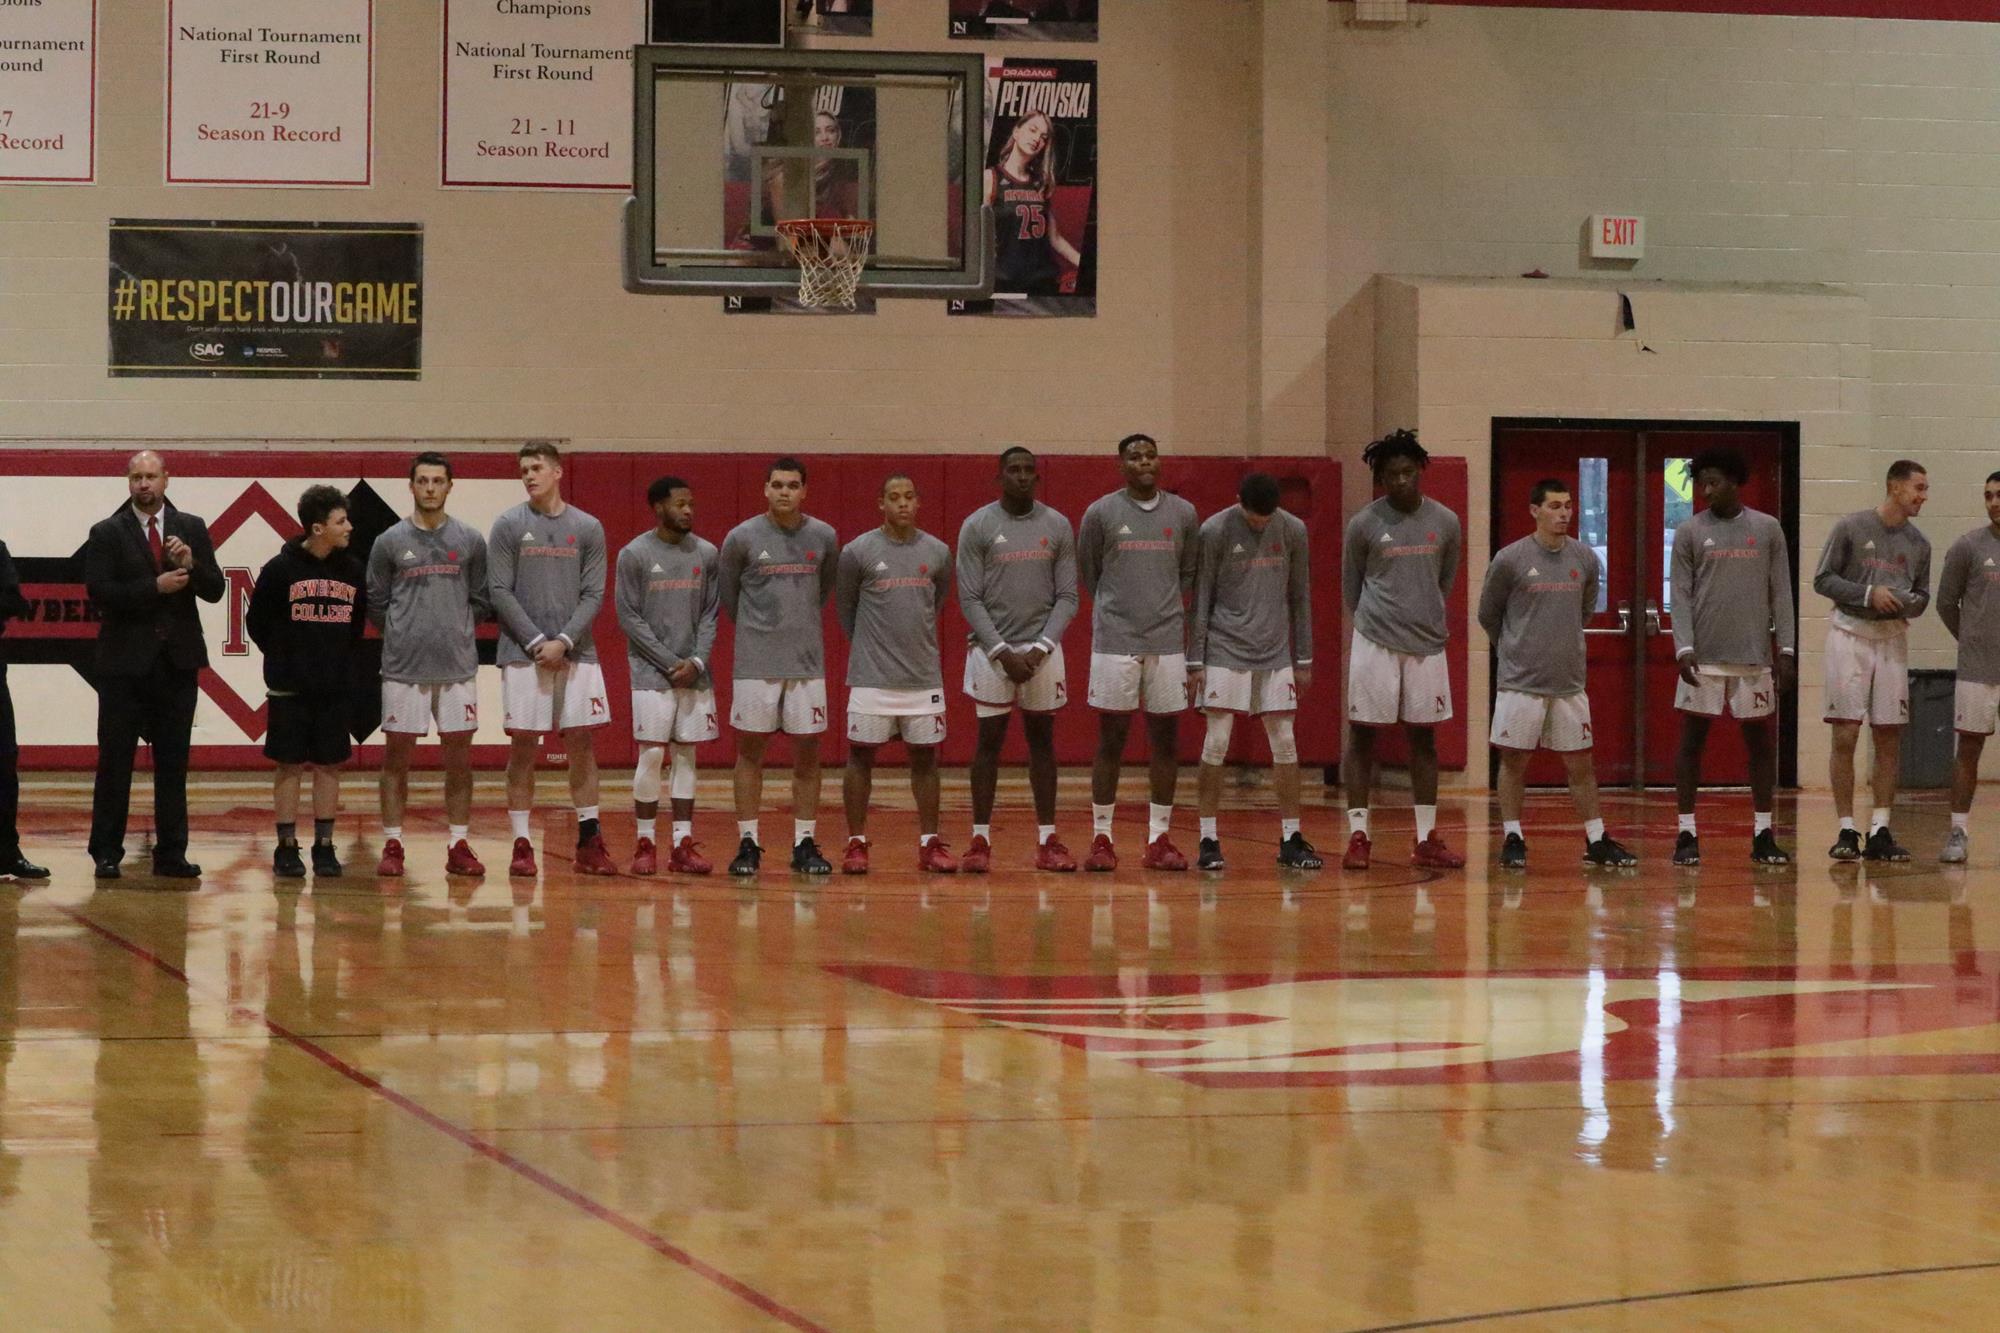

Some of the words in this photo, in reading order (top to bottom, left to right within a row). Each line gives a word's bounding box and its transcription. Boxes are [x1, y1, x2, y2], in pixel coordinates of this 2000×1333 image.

[497, 0, 592, 18] Champions
[180, 26, 252, 42] National
[258, 28, 361, 44] Tournament
[0, 39, 85, 51] urnament
[456, 42, 525, 58] National
[531, 44, 633, 60] Tournament
[220, 49, 259, 63] First
[265, 50, 321, 64] Round
[493, 64, 531, 80] First
[537, 65, 593, 81] Round
[998, 81, 1090, 118] PETKOVSKA
[250, 102, 290, 119] 21-9
[198, 124, 265, 141] Season
[272, 126, 341, 142] Record
[511, 118, 531, 135] 21
[557, 120, 575, 135] 11
[477, 141, 538, 157] Season
[545, 142, 609, 158] Record
[1016, 204, 1046, 240] 25
[1603, 218, 1638, 245] EXIT
[113, 278, 417, 324] #RESPECTOURGAME
[194, 343, 224, 356] SAC
[289, 579, 357, 604] NEWBERRY
[291, 603, 353, 623] COLLEGE
